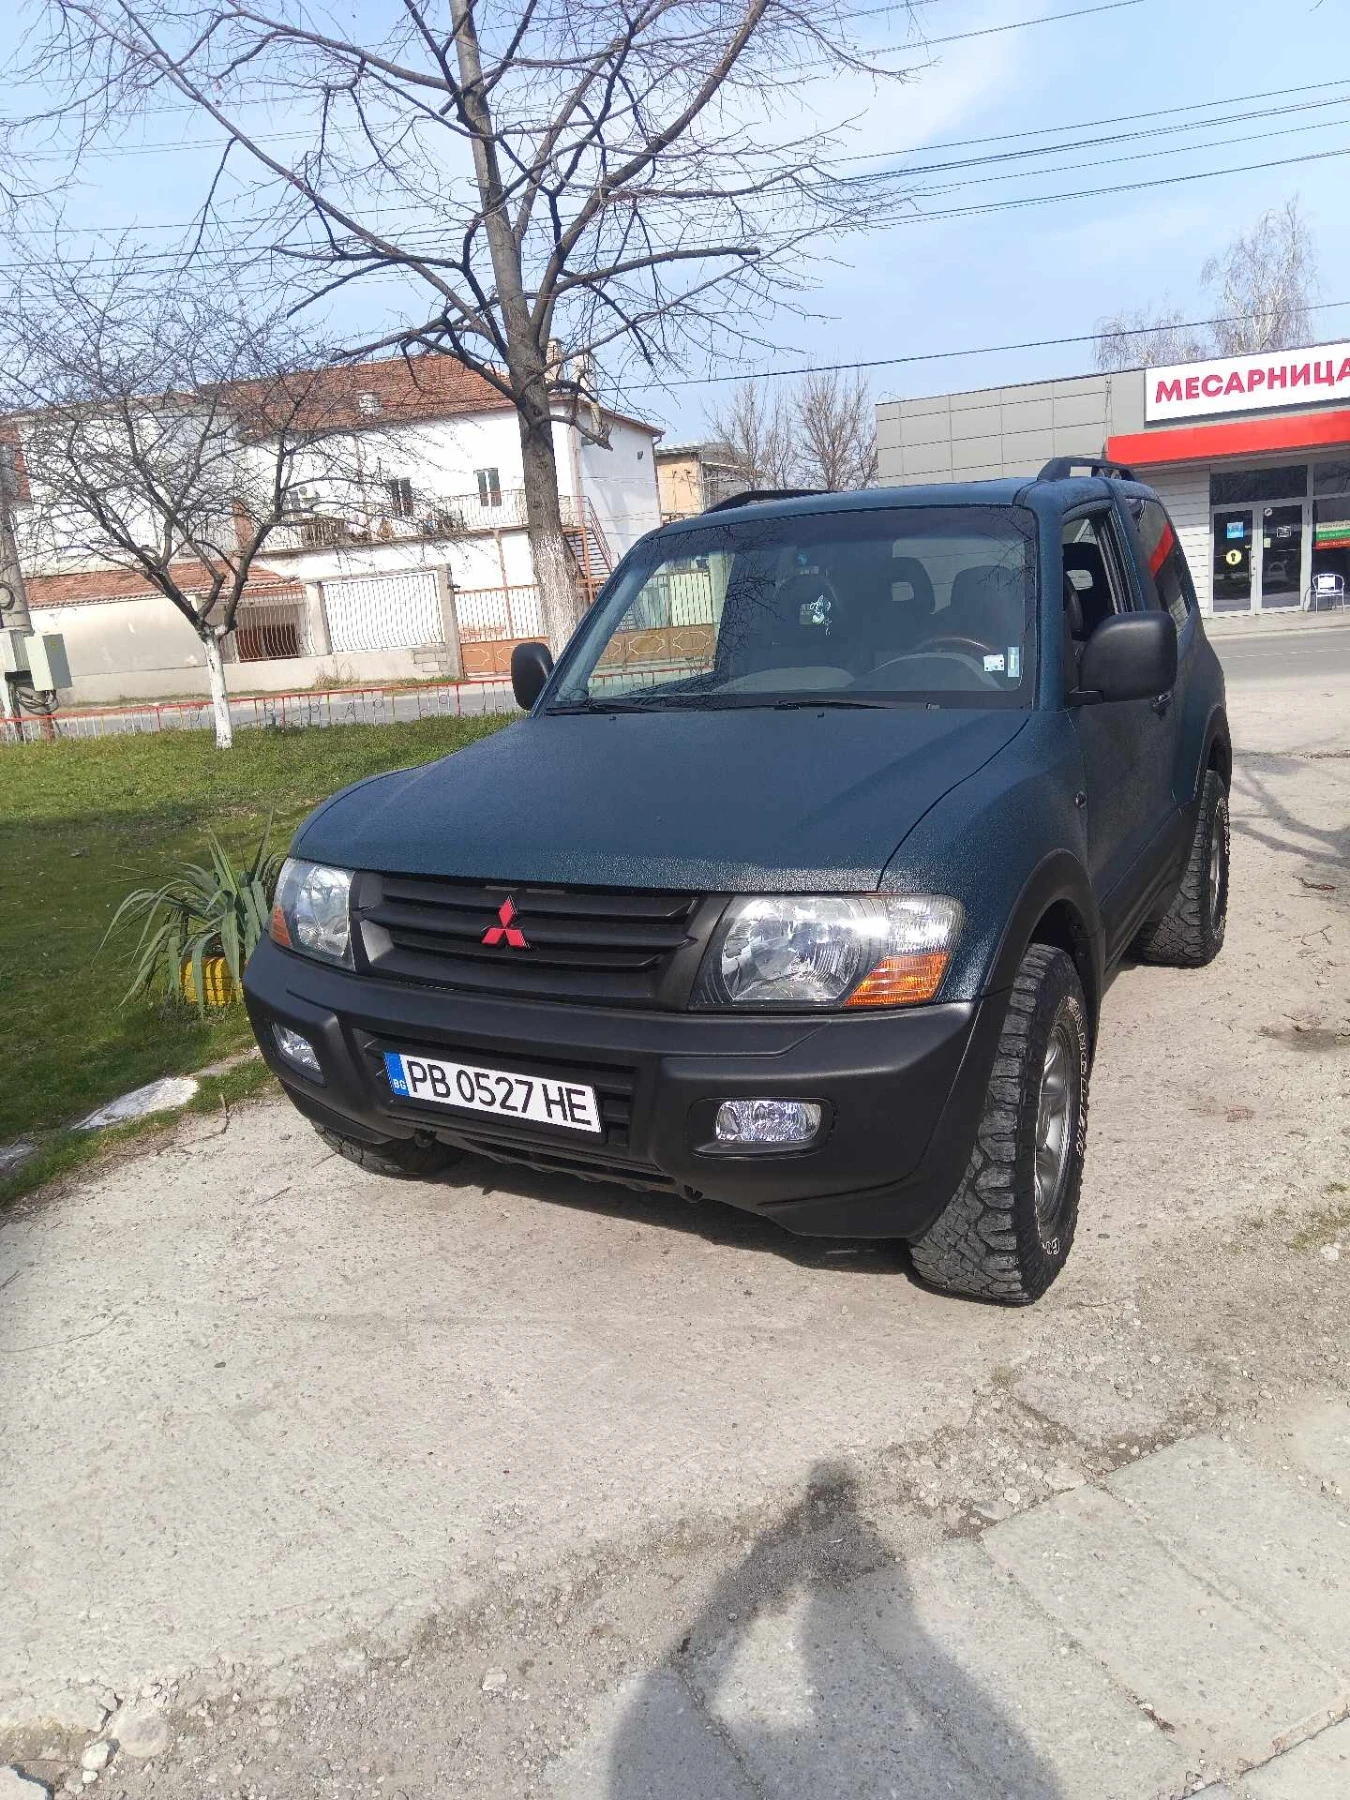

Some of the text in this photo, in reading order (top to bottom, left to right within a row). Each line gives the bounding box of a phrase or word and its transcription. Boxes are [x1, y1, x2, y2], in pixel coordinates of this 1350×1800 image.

[1155, 358, 1350, 403] МЕСАРНИЦА
[392, 1078, 407, 1090] BG
[406, 1060, 593, 1126] PB 0527 HE
